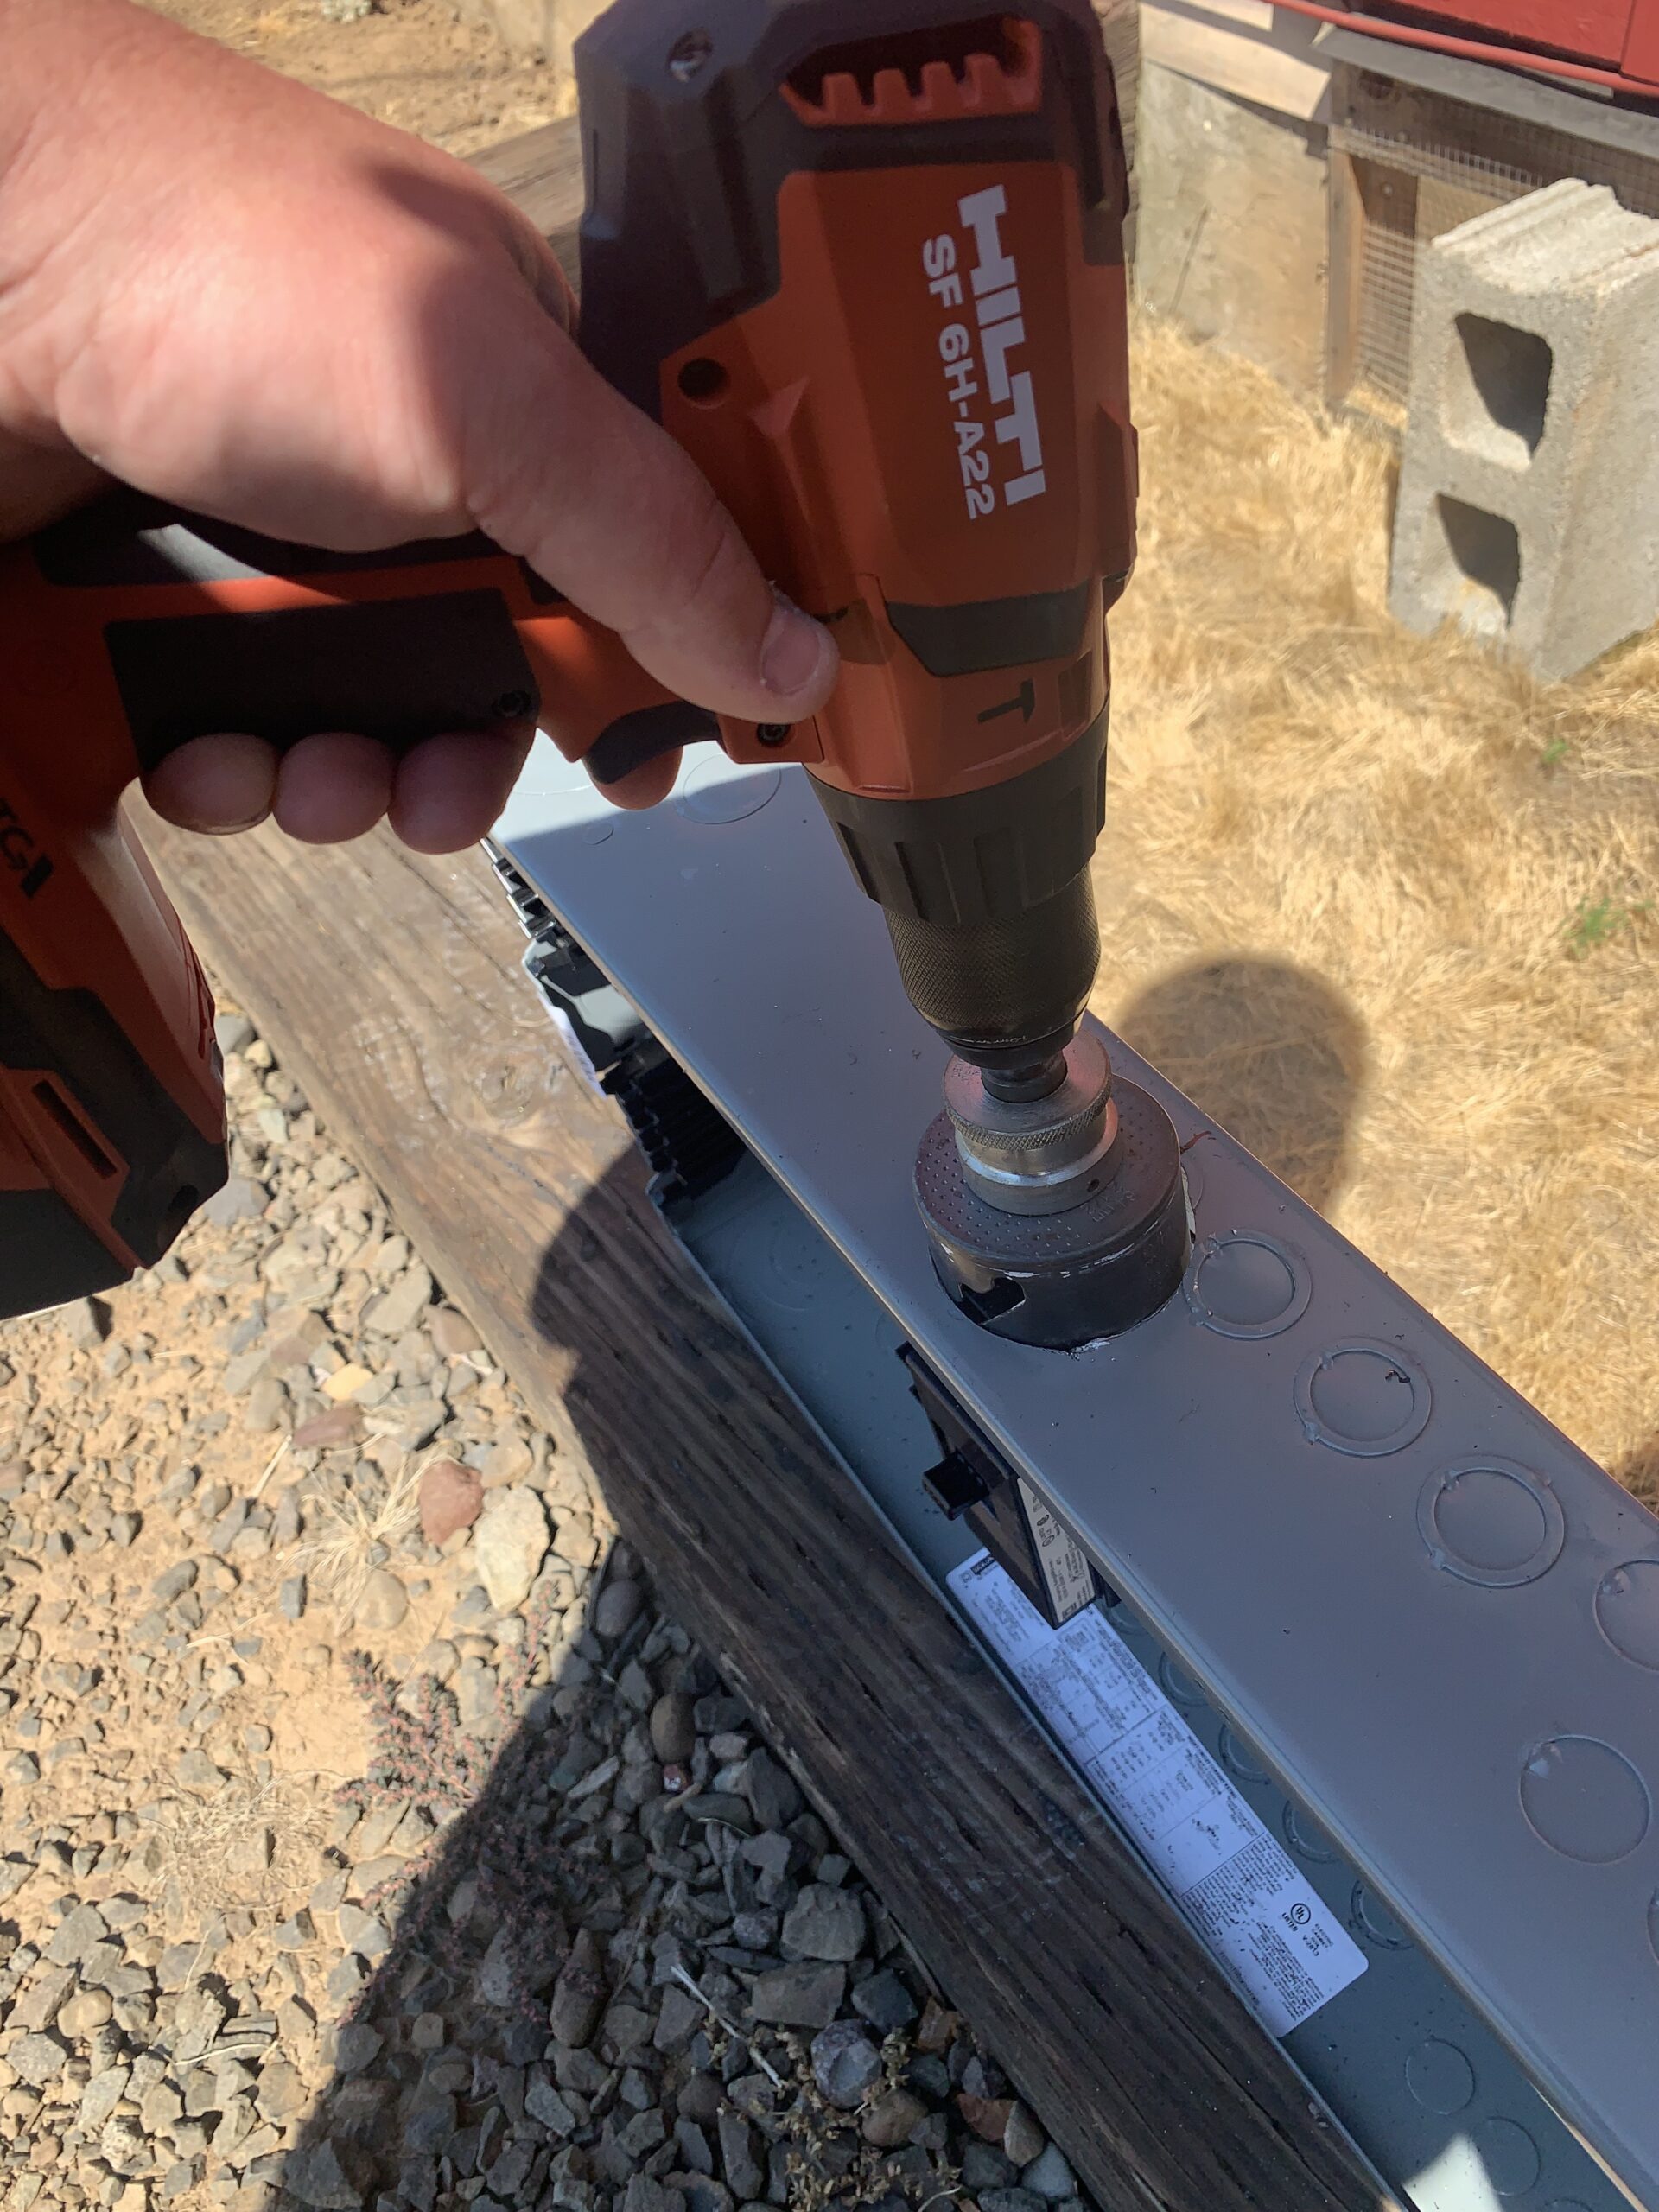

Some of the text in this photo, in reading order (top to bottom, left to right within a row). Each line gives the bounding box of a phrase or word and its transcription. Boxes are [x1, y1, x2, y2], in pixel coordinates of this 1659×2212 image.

[923, 234, 995, 519] SF 6H-A22
[958, 184, 1046, 505] HILTI
